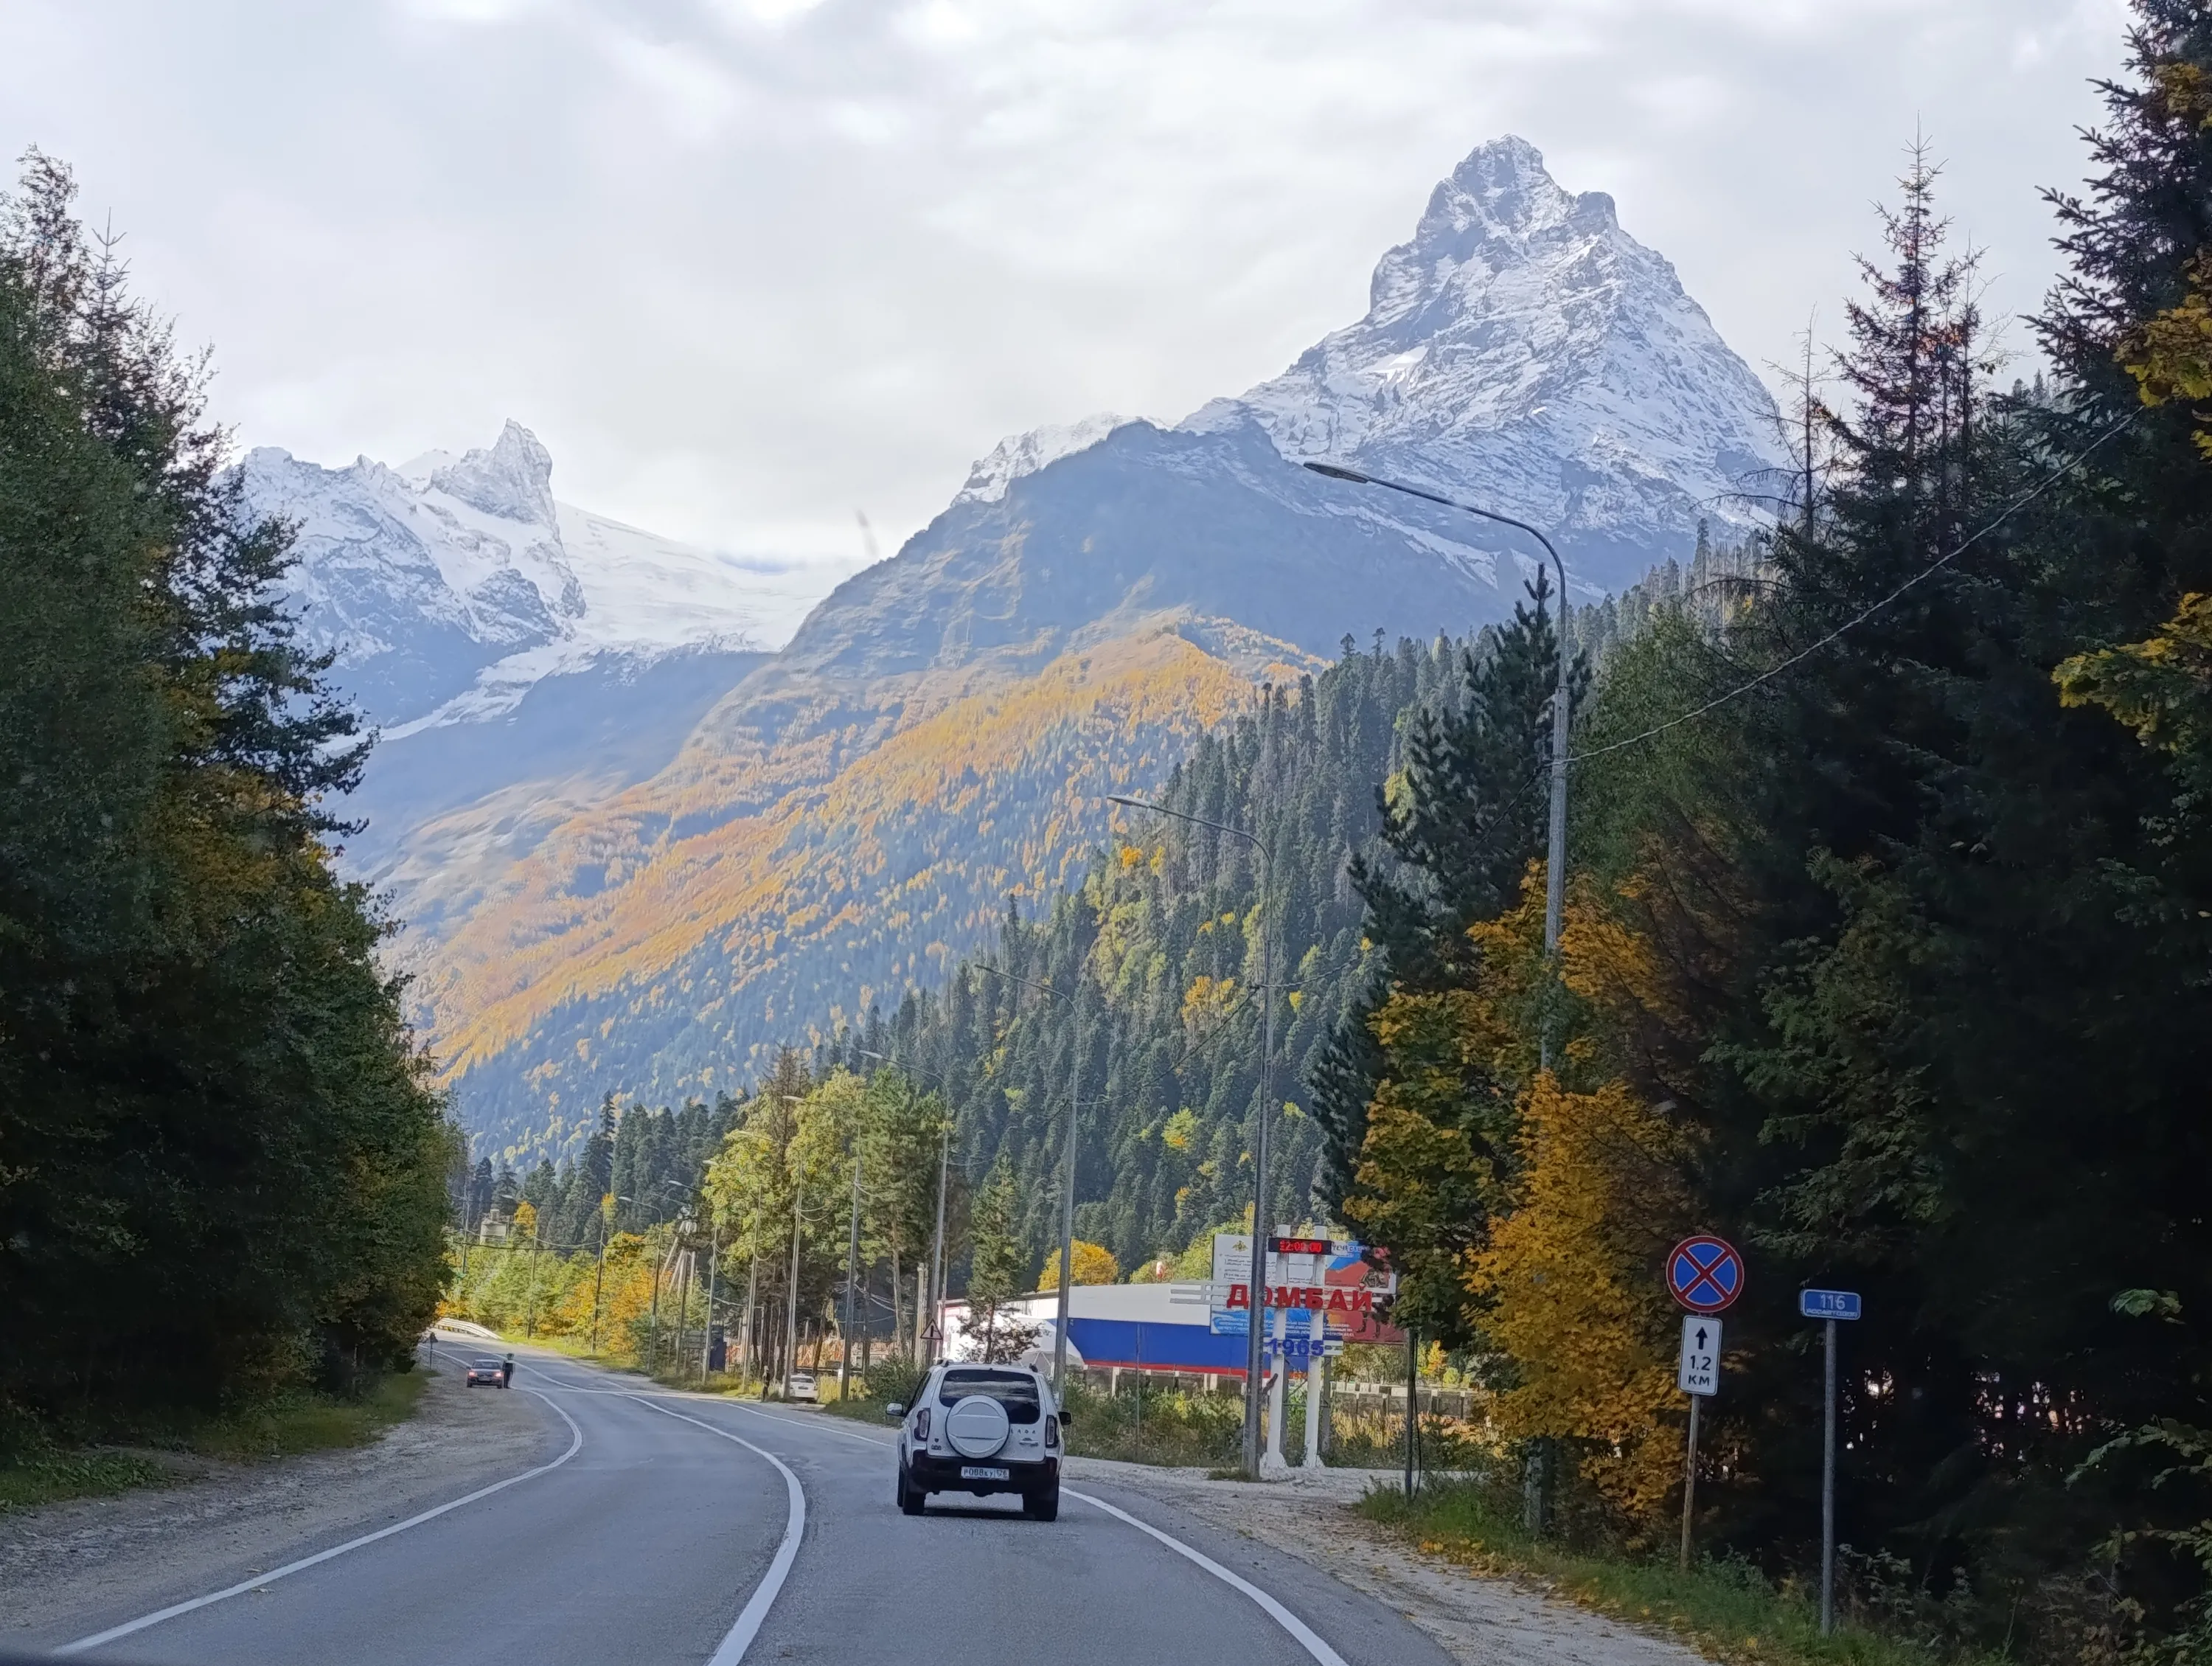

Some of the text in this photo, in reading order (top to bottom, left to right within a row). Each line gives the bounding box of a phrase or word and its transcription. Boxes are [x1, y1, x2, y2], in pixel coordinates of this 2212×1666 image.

[1820, 1294, 1846, 1310] 116
[1264, 1338, 1324, 1356] 1965
[1688, 1374, 1710, 1386] КМ
